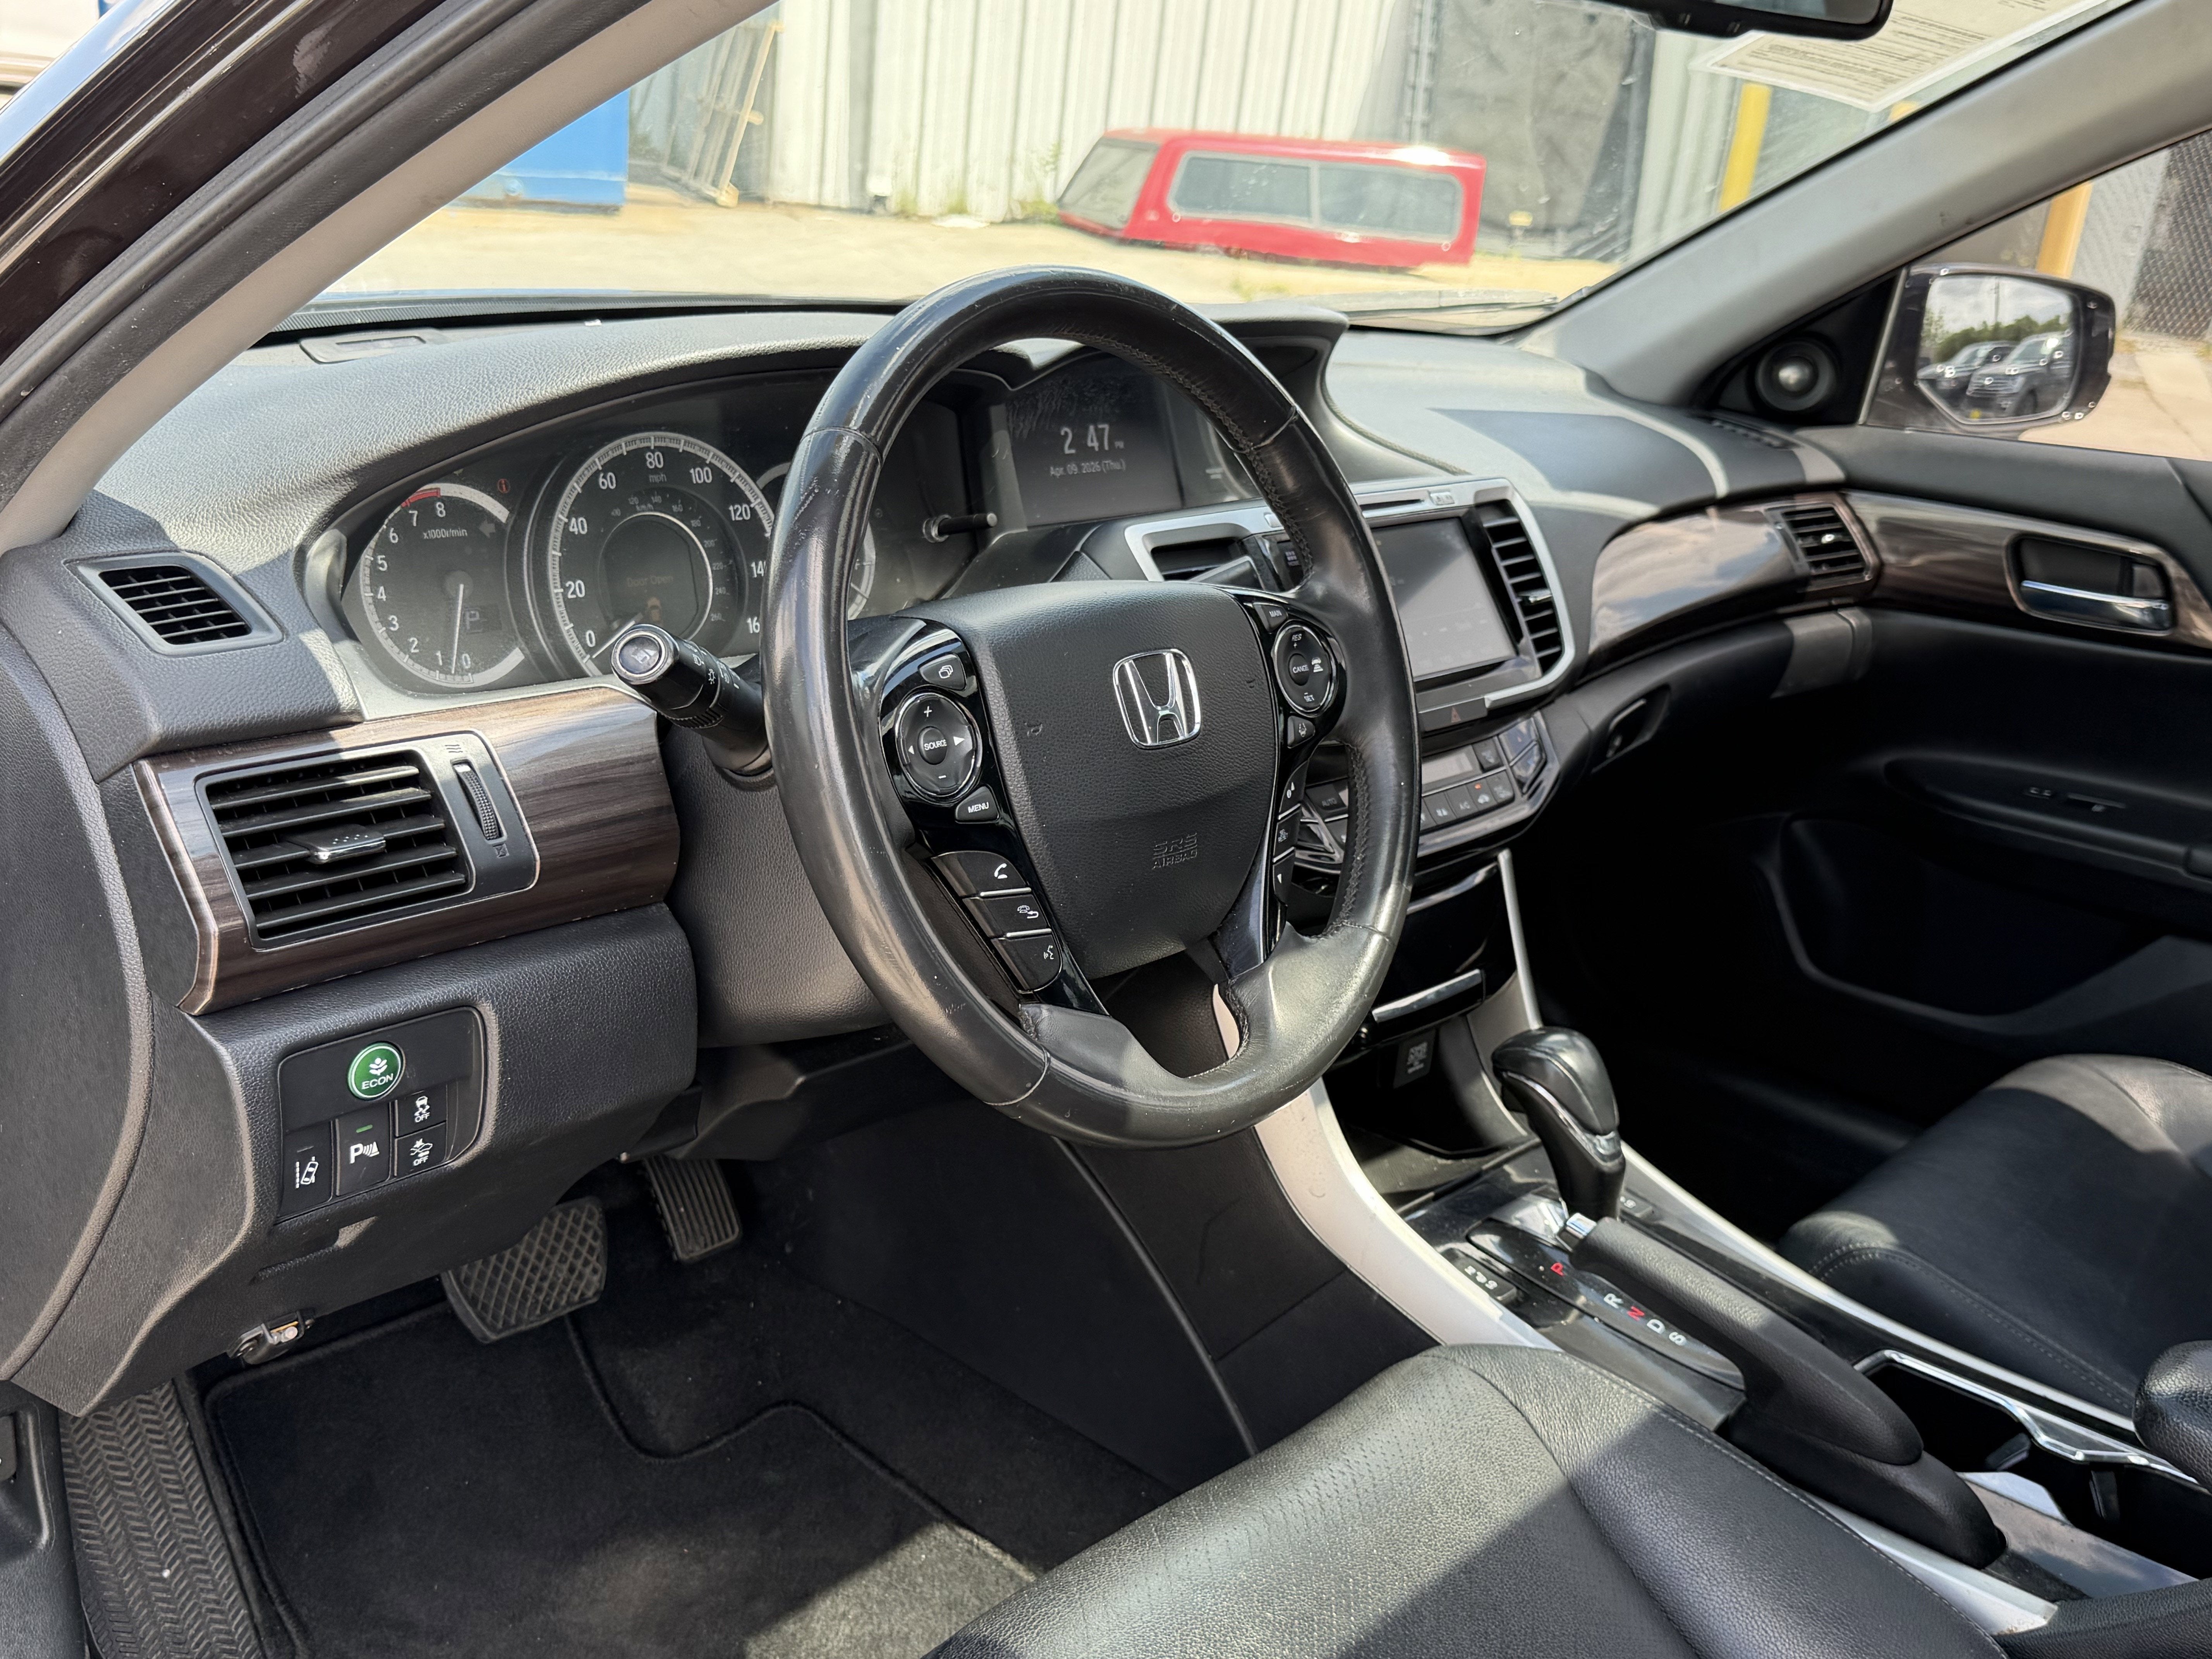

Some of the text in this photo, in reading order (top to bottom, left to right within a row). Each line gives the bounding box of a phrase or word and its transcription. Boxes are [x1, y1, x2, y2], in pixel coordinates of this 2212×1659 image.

[646, 452, 663, 469] 80
[598, 472, 617, 490] 60
[649, 472, 667, 484] mph
[689, 467, 713, 484] 100
[436, 502, 446, 517] 8
[729, 504, 750, 521] 120
[409, 510, 418, 526] 7
[423, 527, 468, 539] x1000r/min
[569, 518, 588, 536] 40
[389, 528, 398, 543] 6
[377, 555, 387, 571] 5
[377, 587, 386, 601] 4
[566, 580, 585, 598] 20
[388, 615, 399, 630] 3
[747, 617, 761, 634] 16
[585, 630, 596, 647] 0
[1291, 633, 1302, 641] RES
[409, 637, 419, 653] 2
[436, 651, 443, 666] 1
[462, 653, 471, 668] 0
[924, 738, 947, 750] SOURCE
[967, 802, 990, 814] MENU
[1152, 833, 1197, 855] SRS
[362, 1073, 394, 1090] ECON
[414, 1112, 431, 1123] OFF
[349, 1142, 362, 1164] P
[413, 1156, 428, 1166] OFF
[1550, 1262, 1564, 1276] P
[1604, 1293, 1623, 1309] R
[1627, 1306, 1645, 1321] N
[1647, 1319, 1665, 1335] D
[1668, 1331, 1686, 1346] S
